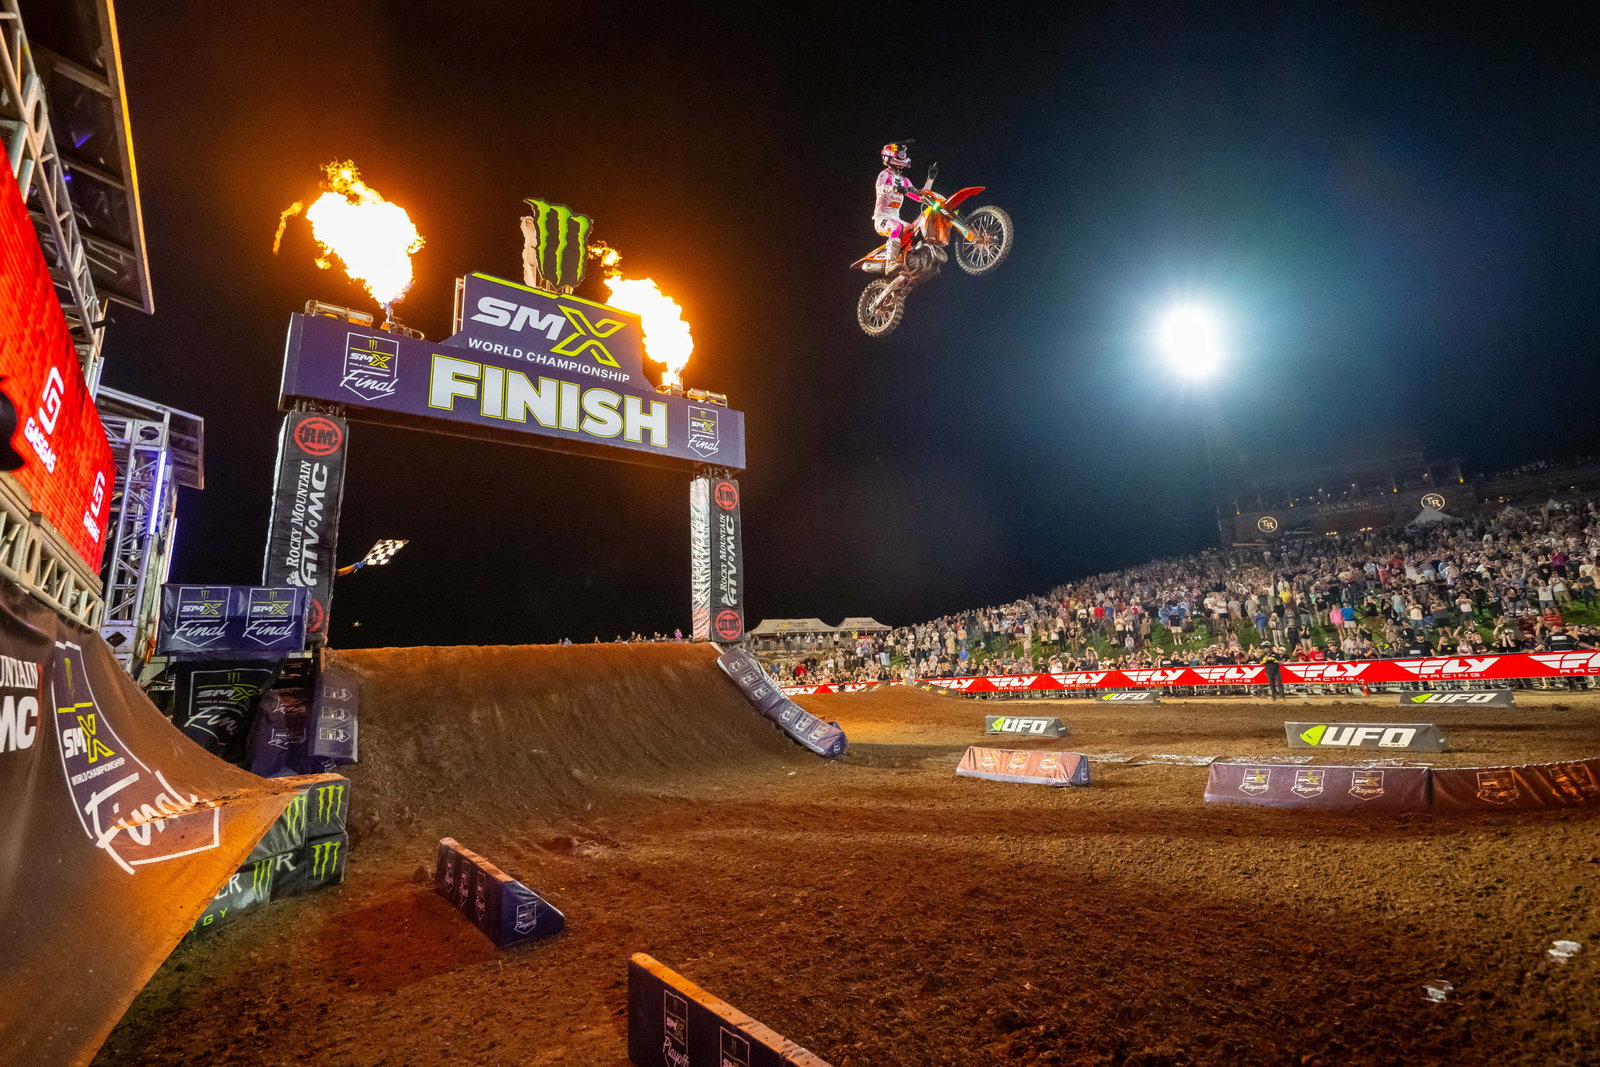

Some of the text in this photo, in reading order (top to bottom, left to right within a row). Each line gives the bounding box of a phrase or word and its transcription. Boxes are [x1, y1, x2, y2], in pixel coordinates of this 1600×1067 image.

[470, 296, 628, 369] SMX
[349, 352, 392, 369] SMX
[468, 337, 631, 383] WORLD CHAMPIONSHIP
[339, 369, 399, 393] Final
[428, 353, 668, 448] FINISH
[691, 421, 715, 433] SMX
[687, 434, 720, 451] Final
[286, 460, 312, 567] ROCKY MOUNTAIN
[719, 513, 728, 591] ROCKY MOUNTAIN
[181, 602, 222, 615] SMX
[251, 603, 290, 615] SMX
[171, 620, 230, 640] Final
[242, 620, 297, 638] Final
[1192, 666, 1266, 680] FLY
[1284, 662, 1372, 678] FLY
[1393, 657, 1500, 674] FLY
[986, 676, 1039, 688] FLY
[1050, 672, 1109, 685] FLY
[1121, 669, 1186, 682] FLY
[1113, 692, 1150, 701] UFO
[1424, 692, 1498, 704] UFO
[1001, 718, 1048, 734] UFO
[62, 713, 116, 765] SMX
[1320, 726, 1417, 748] UFO
[84, 771, 209, 850] Final
